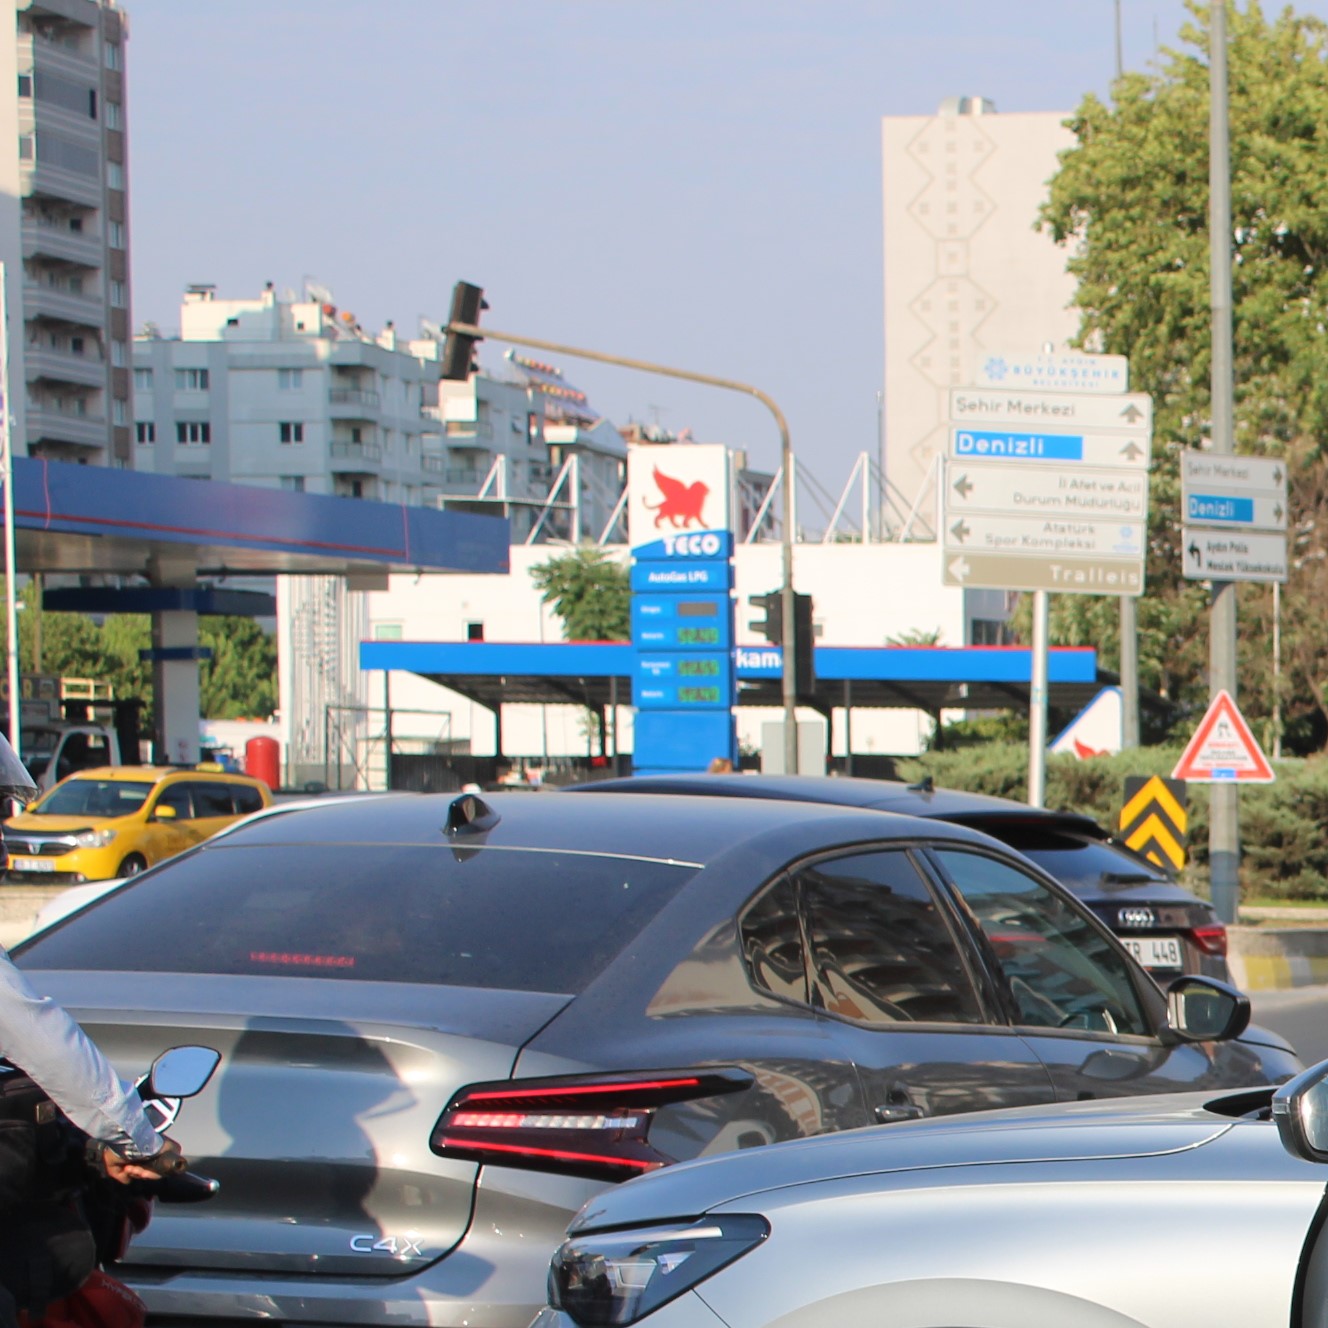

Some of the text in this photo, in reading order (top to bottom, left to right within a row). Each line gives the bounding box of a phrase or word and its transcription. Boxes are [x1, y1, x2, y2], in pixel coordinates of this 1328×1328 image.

[956, 397, 1076, 418] Şehir Merkezi
[958, 433, 1045, 457] Denizli
[1189, 497, 1235, 517] Denizli
[662, 534, 721, 556] TECO
[688, 569, 709, 583] LPG
[1050, 564, 1140, 586] Tralleis
[736, 648, 782, 669] kam
[1151, 941, 1178, 963] 448
[350, 1233, 425, 1258] C4X
